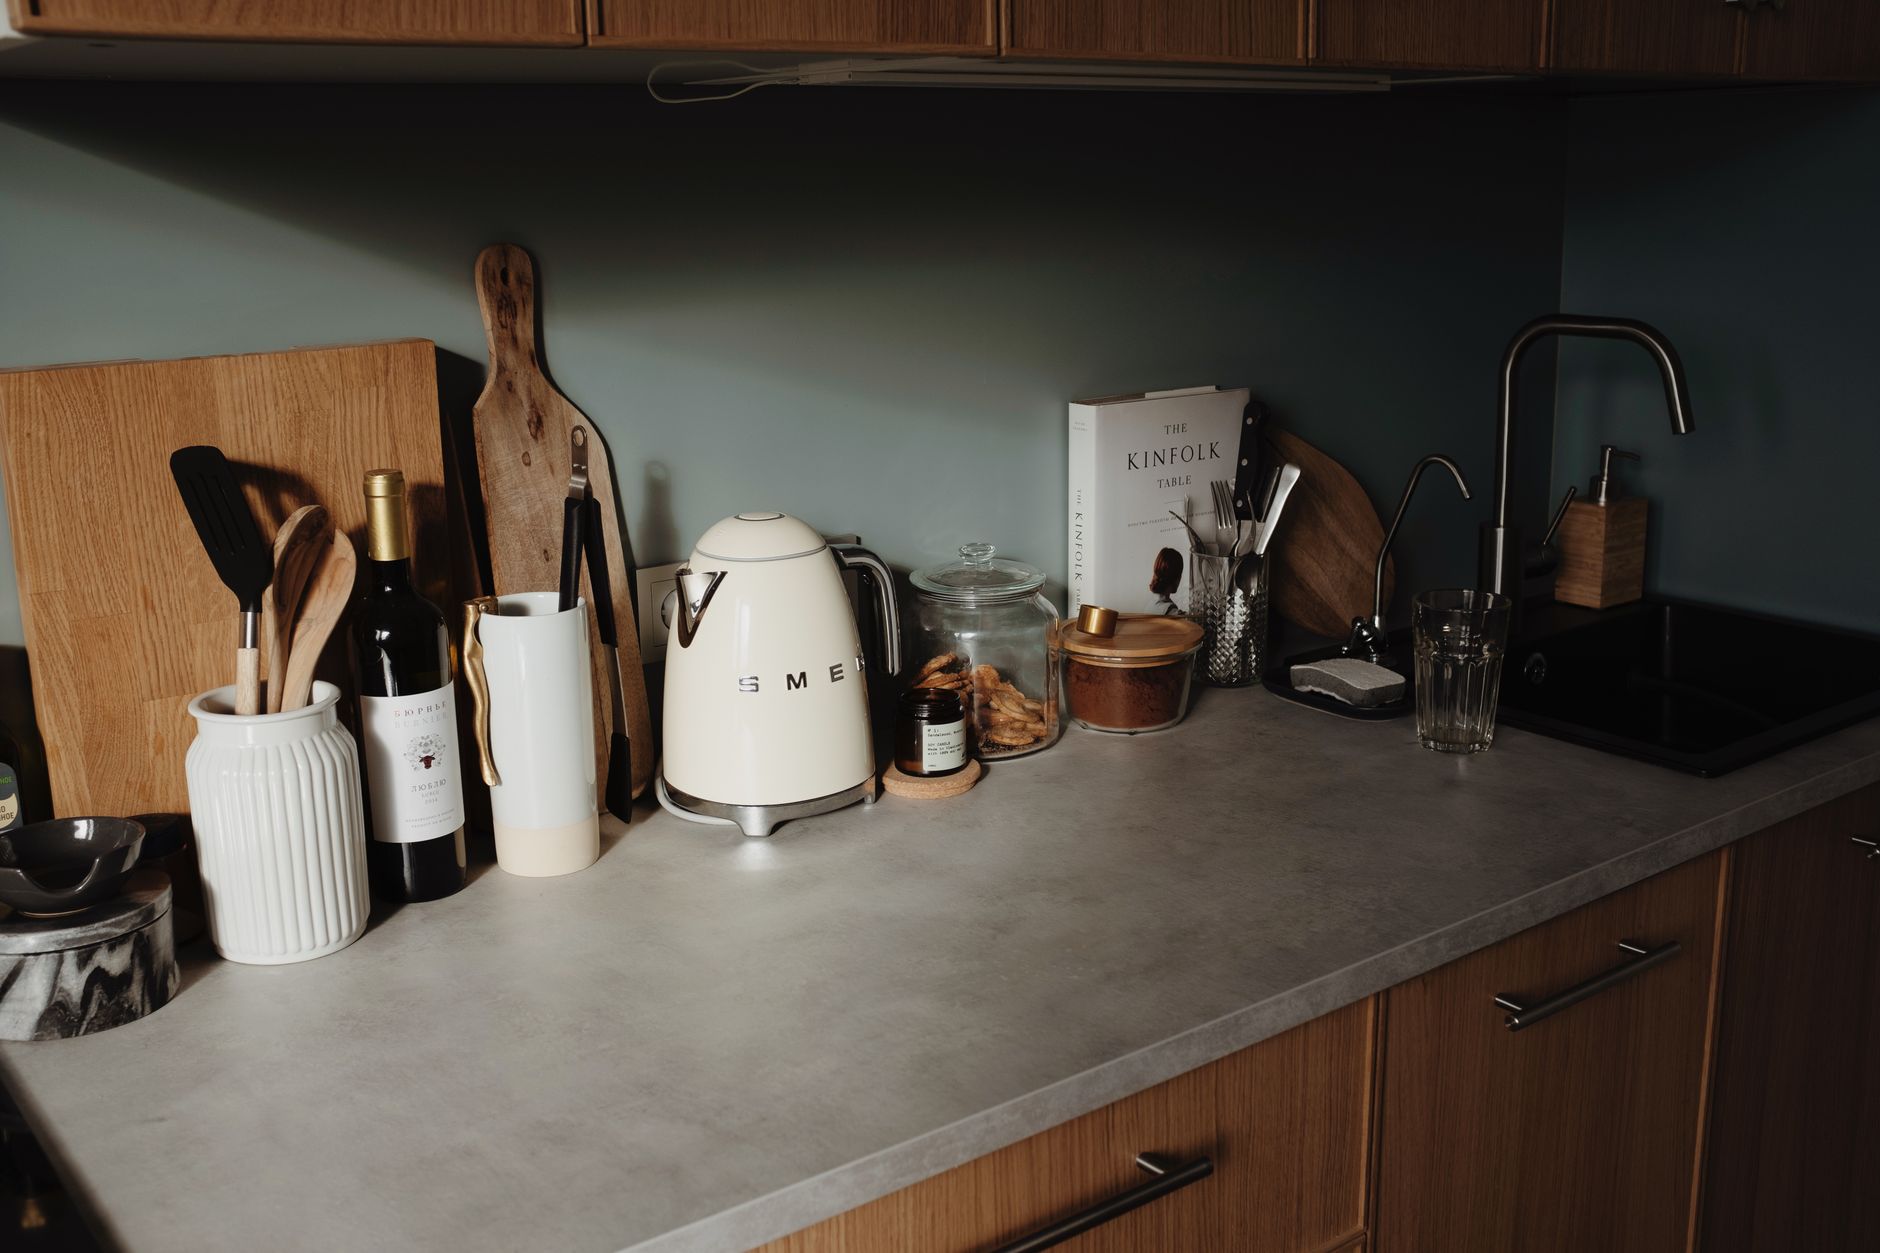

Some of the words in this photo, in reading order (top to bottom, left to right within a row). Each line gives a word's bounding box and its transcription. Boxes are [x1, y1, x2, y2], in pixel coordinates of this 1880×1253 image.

[1164, 423, 1188, 435] THE
[1127, 441, 1220, 471] KINFOLK
[1157, 475, 1192, 489] TABLE
[1074, 512, 1083, 581] KINFOLK
[411, 779, 447, 793] ЛЮБЛЮ
